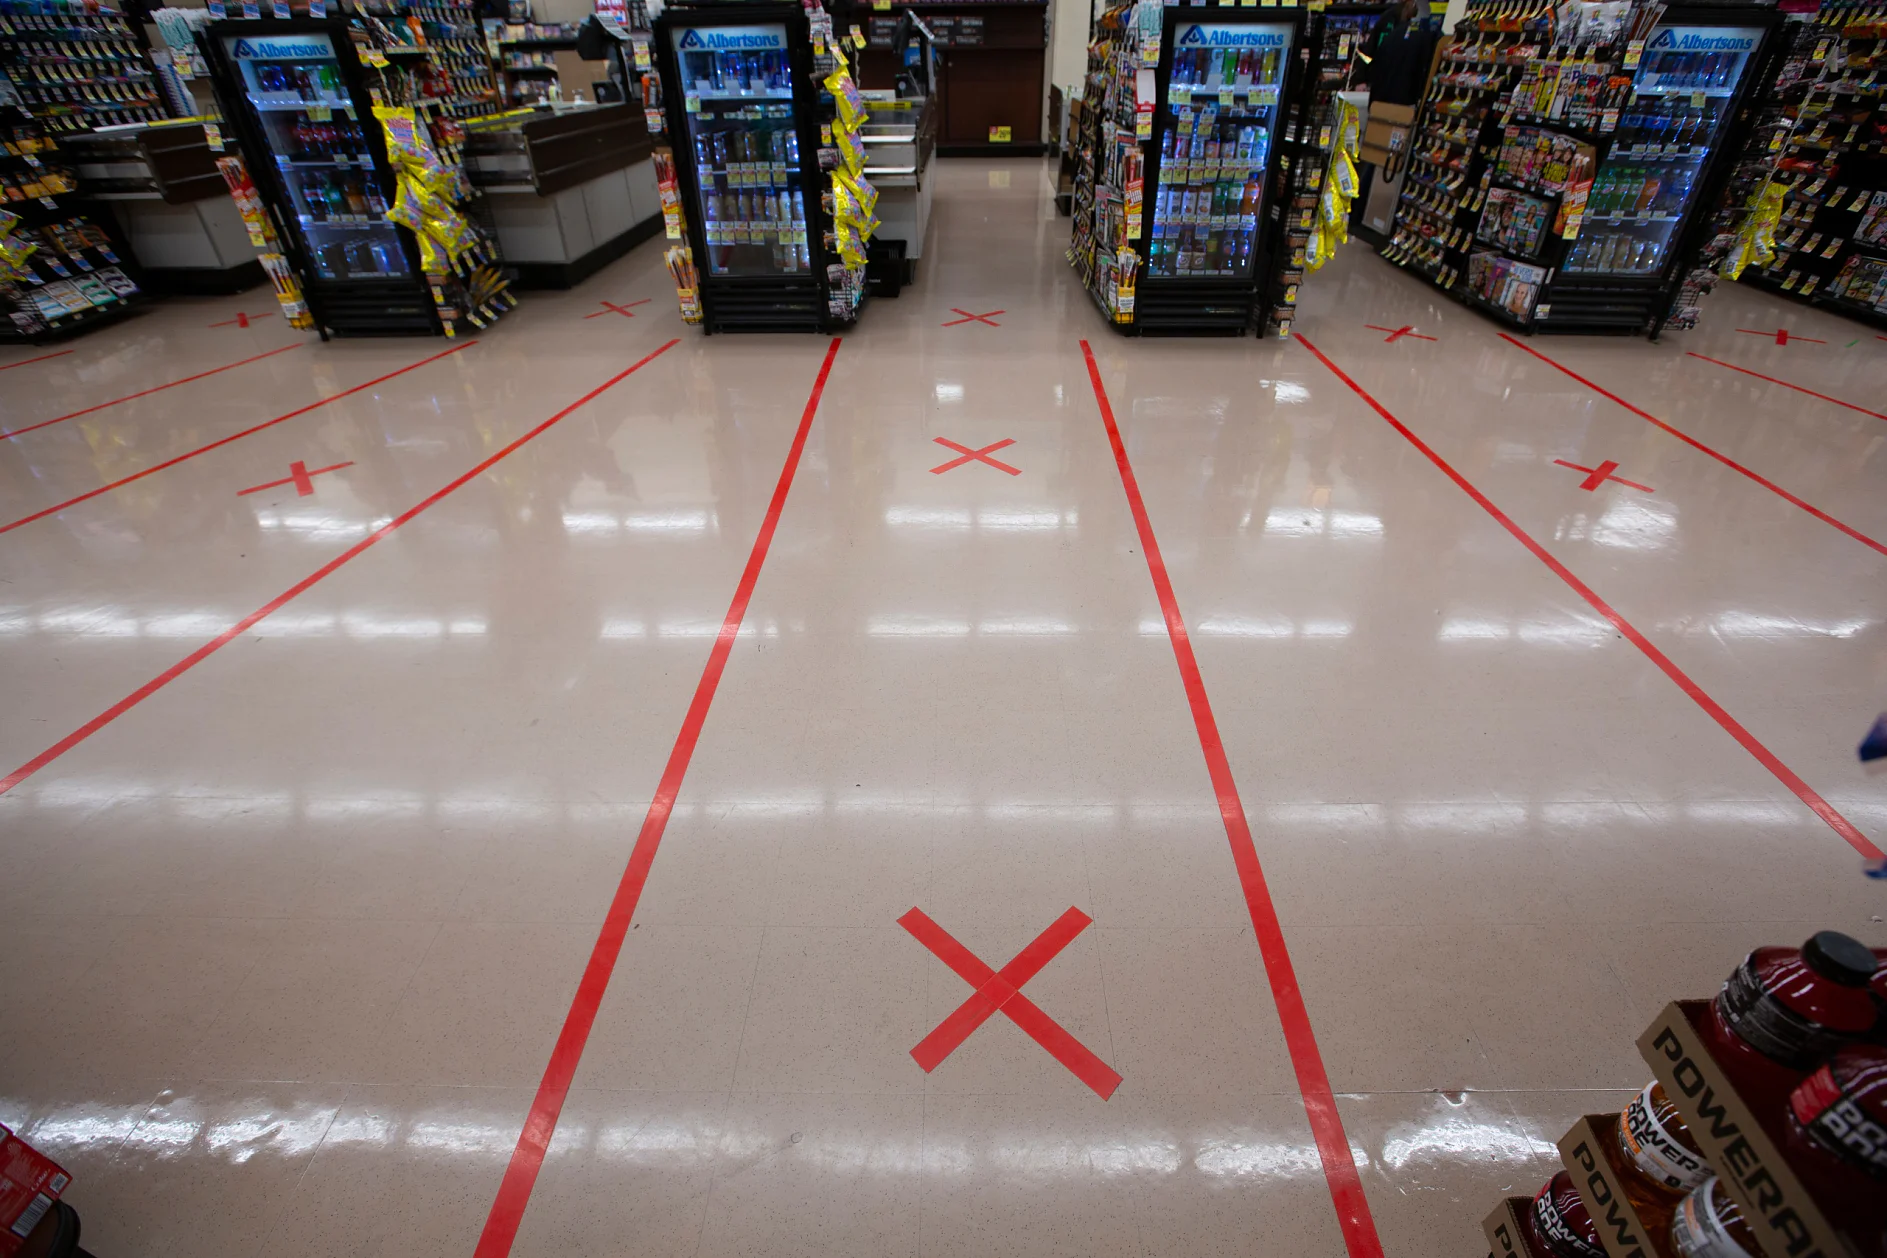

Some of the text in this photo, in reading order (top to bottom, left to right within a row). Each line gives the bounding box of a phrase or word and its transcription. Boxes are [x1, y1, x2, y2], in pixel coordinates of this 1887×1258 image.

[258, 42, 329, 58] Albertsons
[706, 32, 780, 49] Albertsons
[1208, 29, 1284, 47] Albertsons
[1677, 33, 1753, 51] Albertsons
[1628, 1103, 1650, 1149] ADE
[1636, 1093, 1699, 1171] POWER
[1653, 1026, 1825, 1258] POWERA
[1537, 1198, 1563, 1241] ADE
